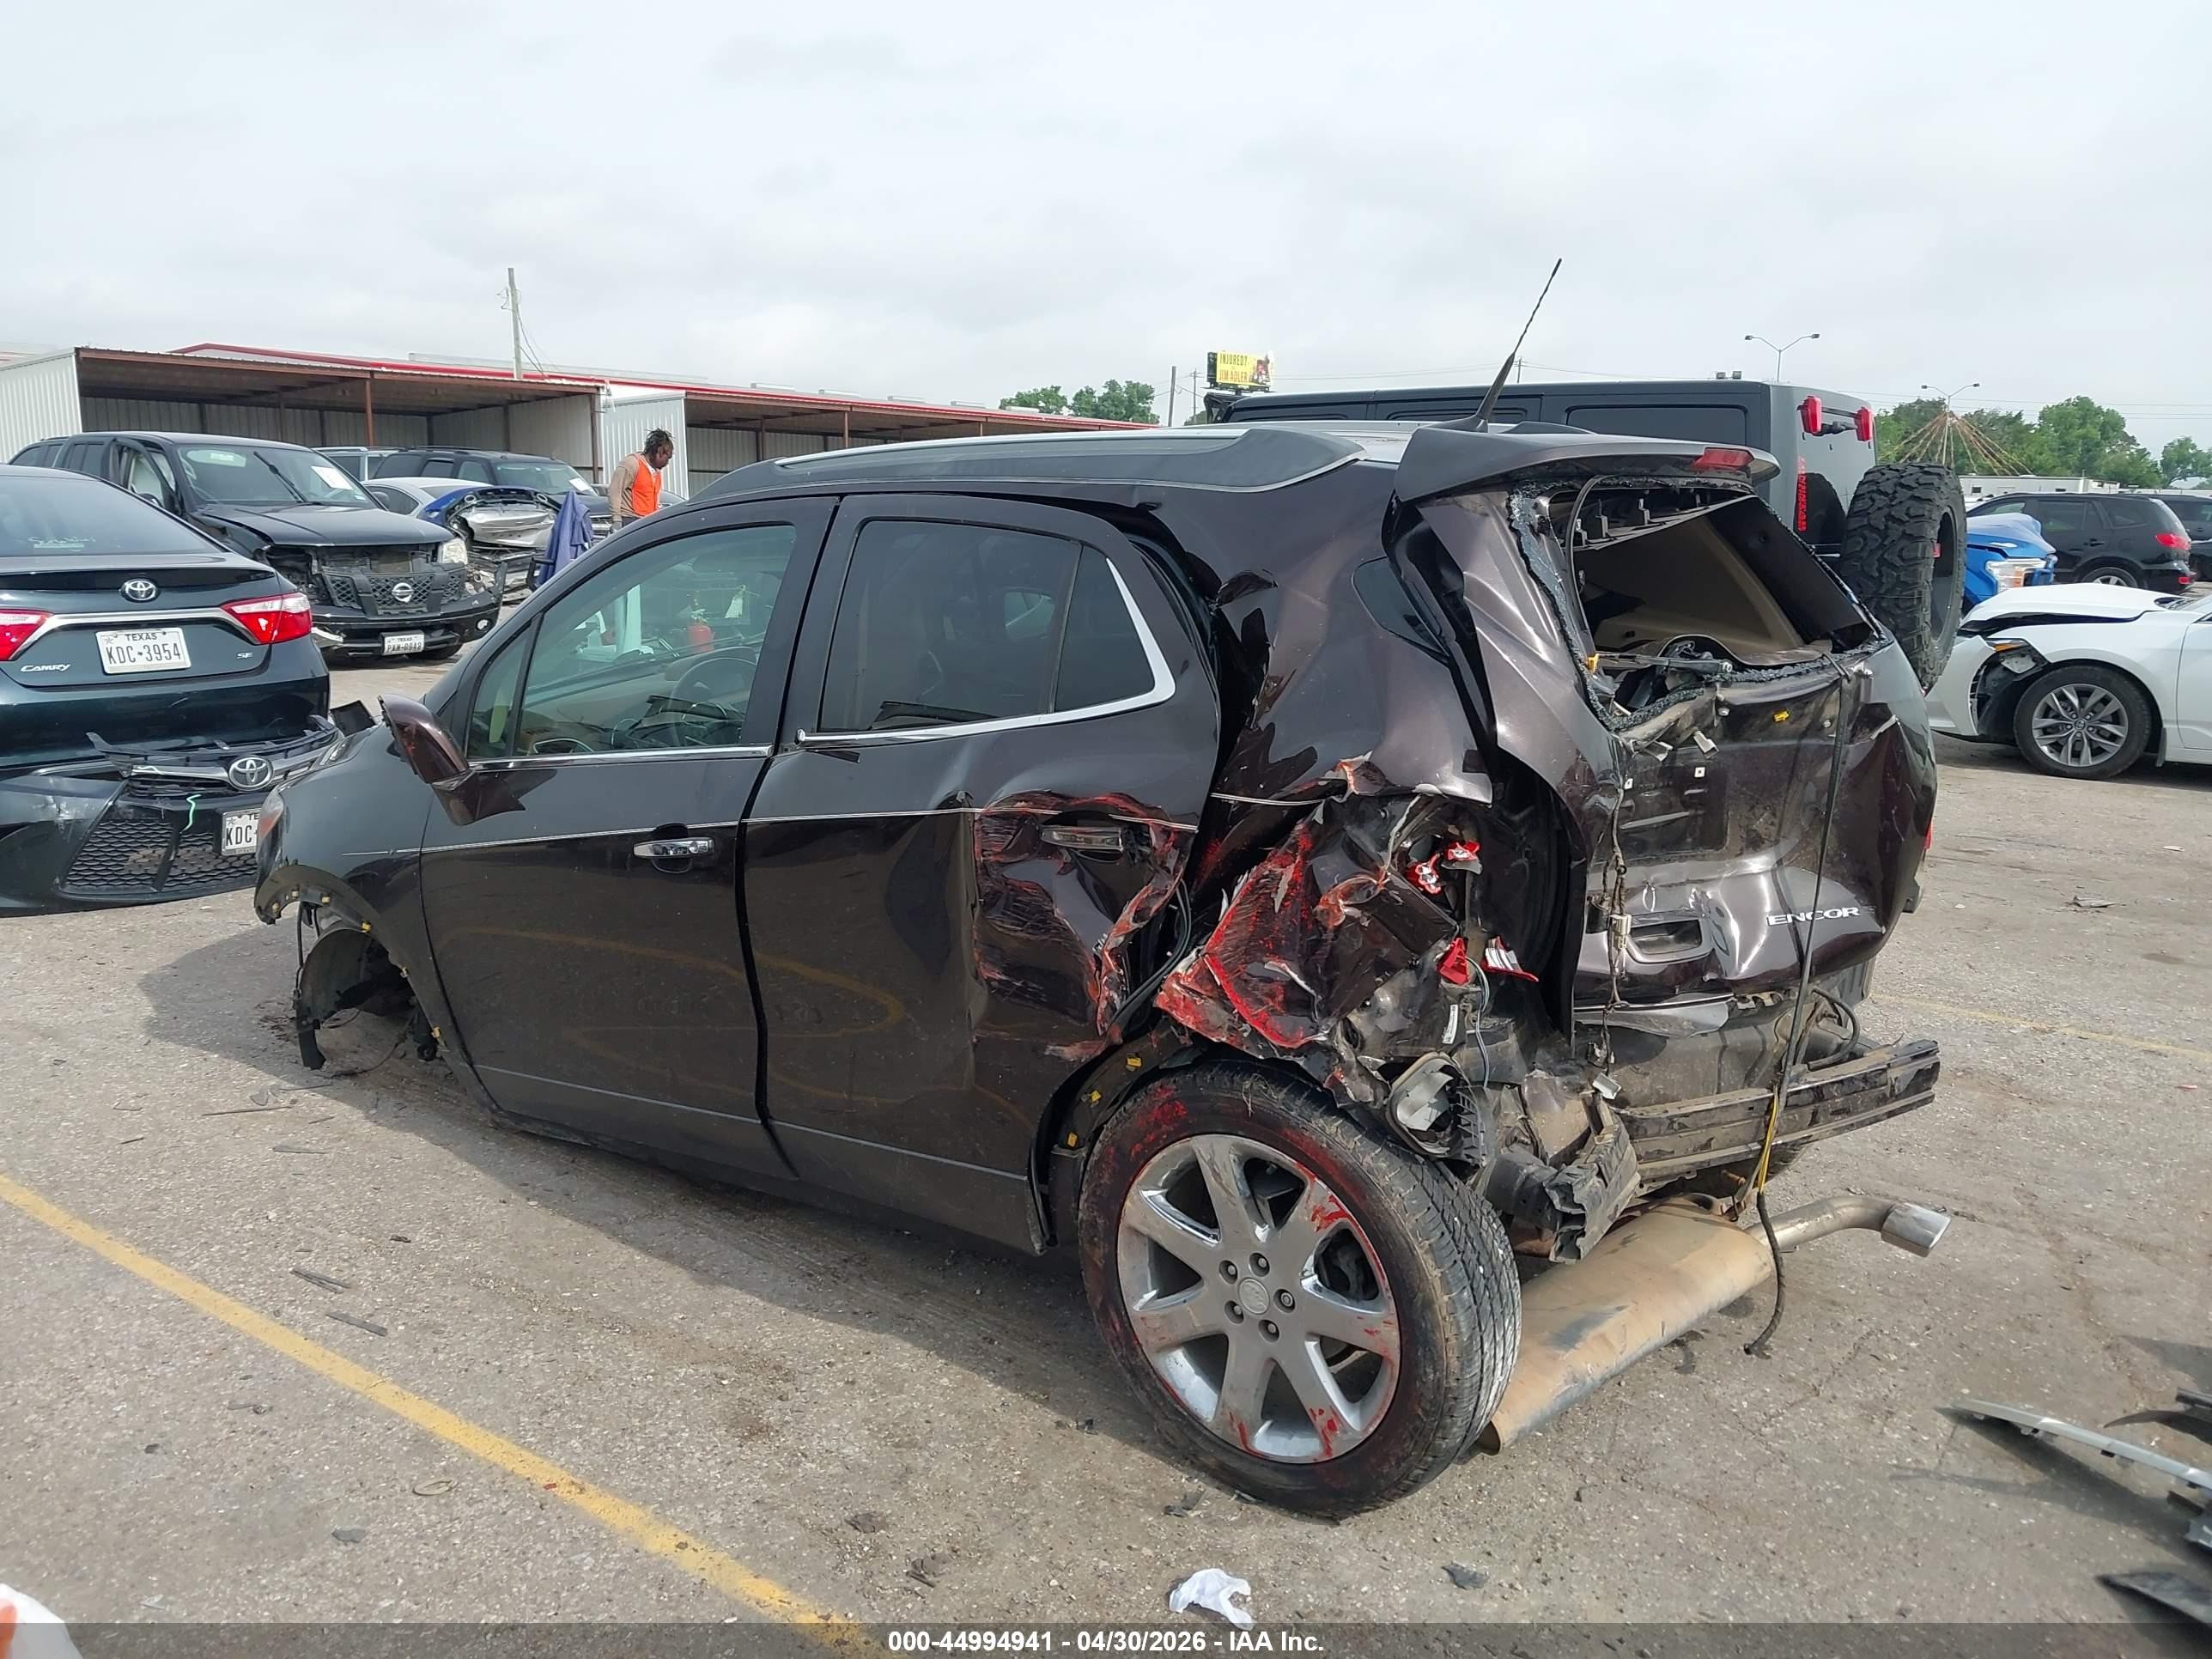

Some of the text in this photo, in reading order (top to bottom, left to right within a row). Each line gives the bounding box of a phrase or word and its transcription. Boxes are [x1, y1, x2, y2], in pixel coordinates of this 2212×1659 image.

[1230, 370, 1248, 383] ADLER
[125, 632, 157, 641] TEXAS
[1766, 907, 1862, 926] ENCOR
